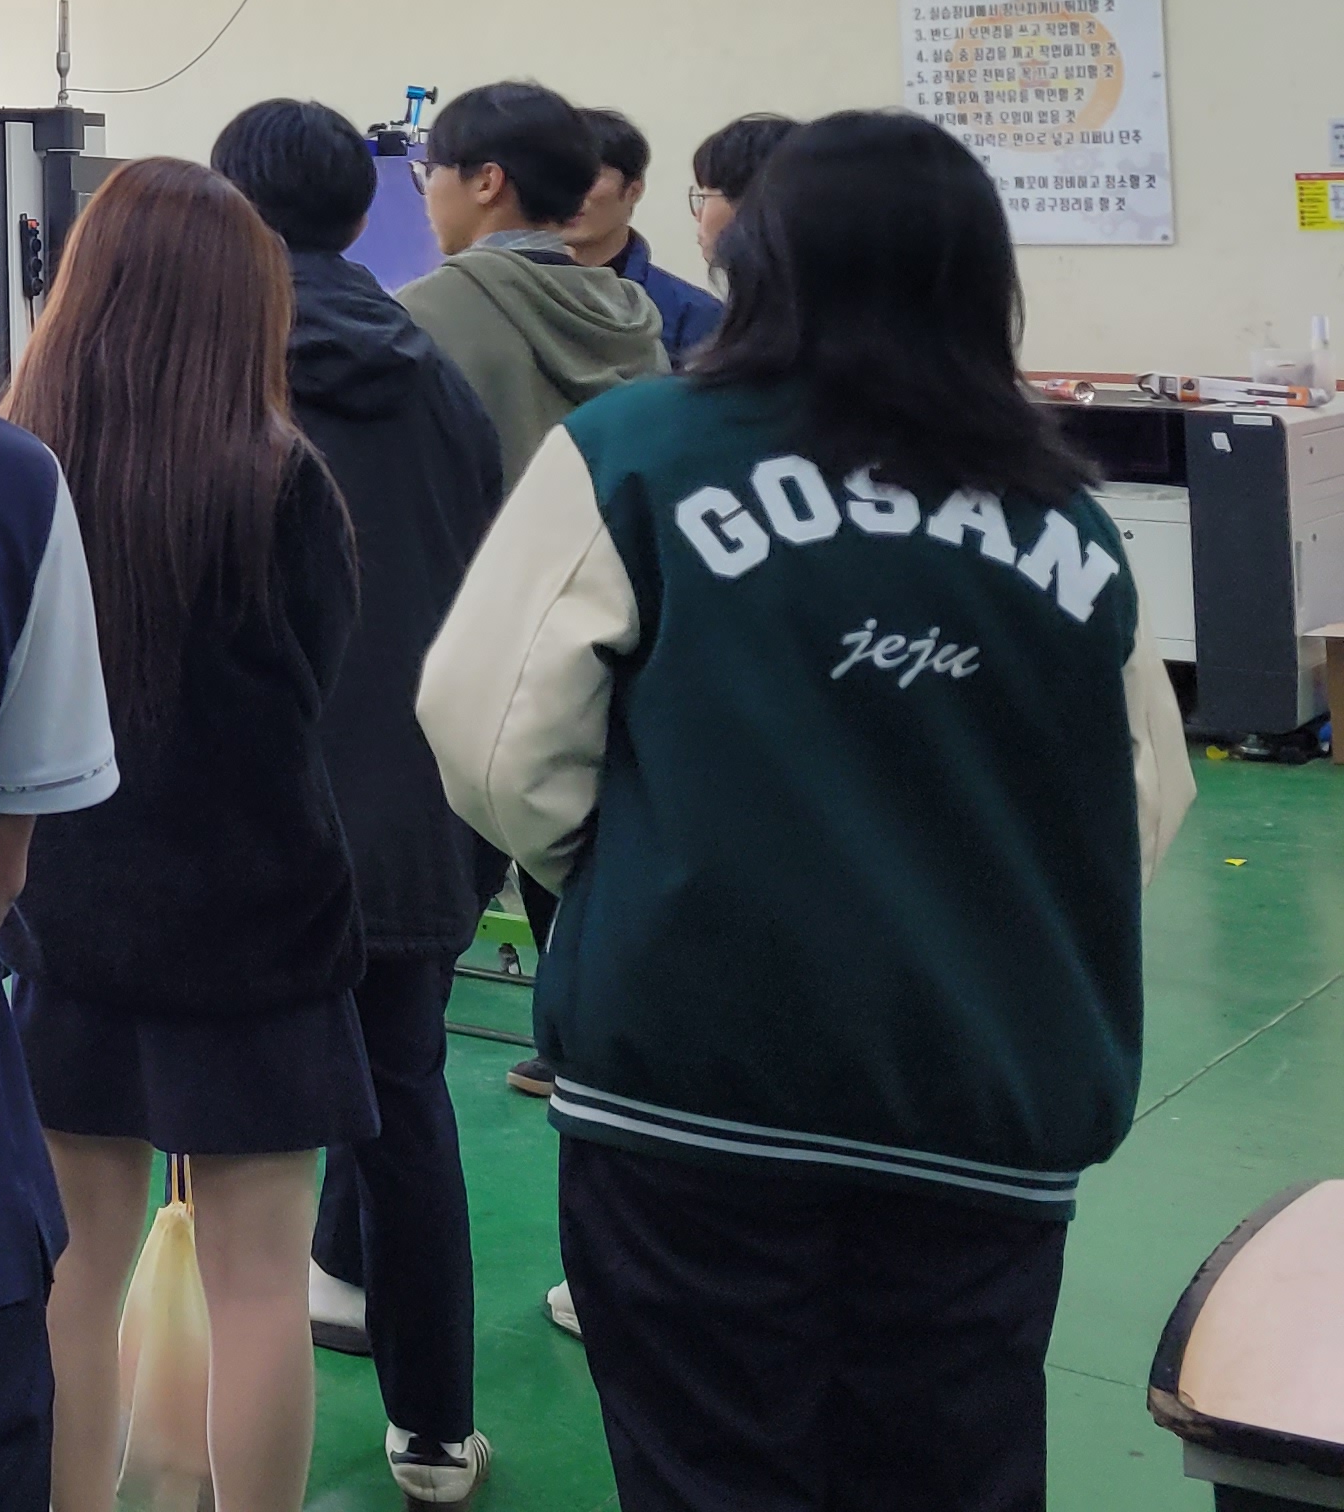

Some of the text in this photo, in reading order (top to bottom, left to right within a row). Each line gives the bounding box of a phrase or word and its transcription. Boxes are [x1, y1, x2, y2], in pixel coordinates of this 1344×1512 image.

[930, 4, 998, 20] 실습장내에서
[1002, 1, 1060, 16] 장난치거나
[931, 28, 964, 40] 반드시
[969, 25, 1012, 39] 보안경을
[1019, 24, 1040, 36] 쓰고
[1045, 22, 1080, 35] 작업할
[1085, 21, 1096, 34] 것
[916, 42, 1118, 63] 4. 실습 중 장갑을 끼고 작업하지 말 것
[917, 74, 928, 84] 5.
[933, 69, 977, 83] 공작물은
[982, 67, 1016, 82] 전원을
[1036, 66, 1058, 80] 끄고
[1064, 65, 1098, 79] 설치할
[1104, 64, 1114, 78] 것
[918, 95, 929, 105] 6.
[933, 91, 979, 105] 윤활유와
[1034, 88, 1069, 102] 확인할
[1074, 88, 1084, 101] 것
[973, 112, 994, 125] 각종
[1000, 110, 1033, 124] 오일이
[1038, 110, 1060, 124] 없을
[1065, 110, 1076, 123] 것
[1013, 133, 1047, 146] 안으로
[1052, 131, 1074, 145] 넣고
[1080, 130, 1113, 144] 지퍼나
[1119, 130, 1142, 144] 단추
[1014, 176, 1049, 189] 깨끗이
[1053, 175, 1100, 189] 정비하고
[1105, 175, 1140, 189] 청소할
[1145, 174, 1156, 189] 것
[1036, 197, 1092, 212] 공구정리를
[1099, 197, 1110, 211] 할
[1115, 196, 1126, 211] 것
[675, 454, 1119, 624] GOSAN
[830, 617, 980, 689] jeju
